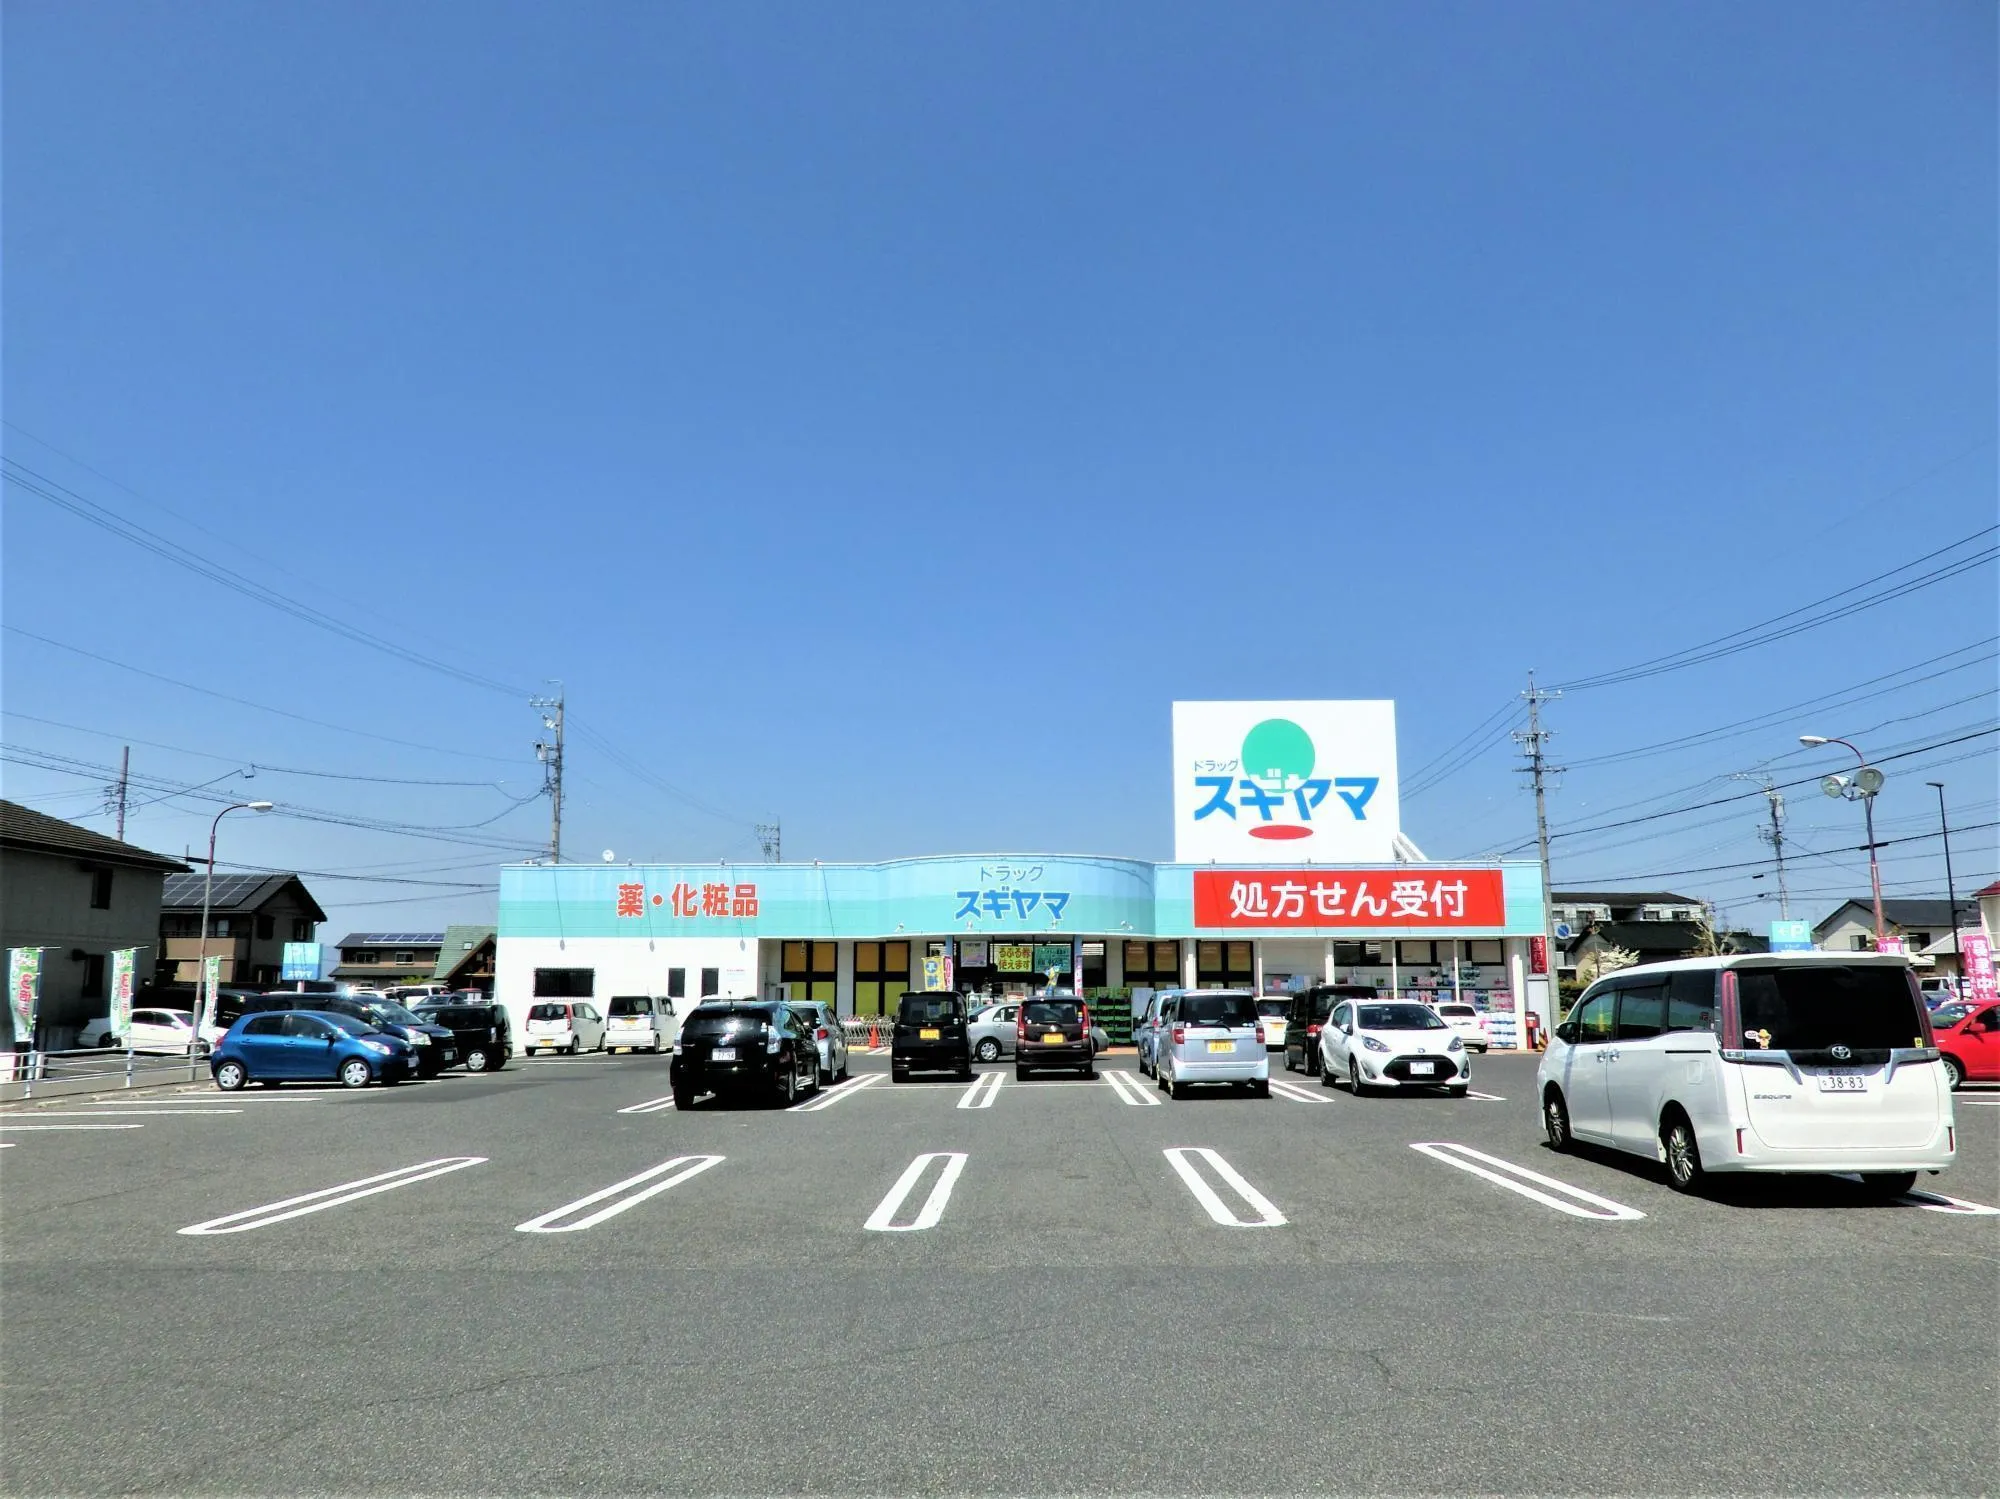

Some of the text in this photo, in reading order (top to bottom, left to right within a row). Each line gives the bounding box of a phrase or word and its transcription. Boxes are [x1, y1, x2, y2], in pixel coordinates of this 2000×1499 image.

[1194, 760, 1239, 772] ドラッグ
[1194, 768, 1380, 821] スギヤマ
[981, 865, 1044, 881] ドラッグ
[616, 883, 759, 918] 薬・化粧品
[955, 886, 1071, 920] スギヤマ
[1230, 880, 1468, 917] 処方せん受付
[1791, 924, 1804, 938] P
